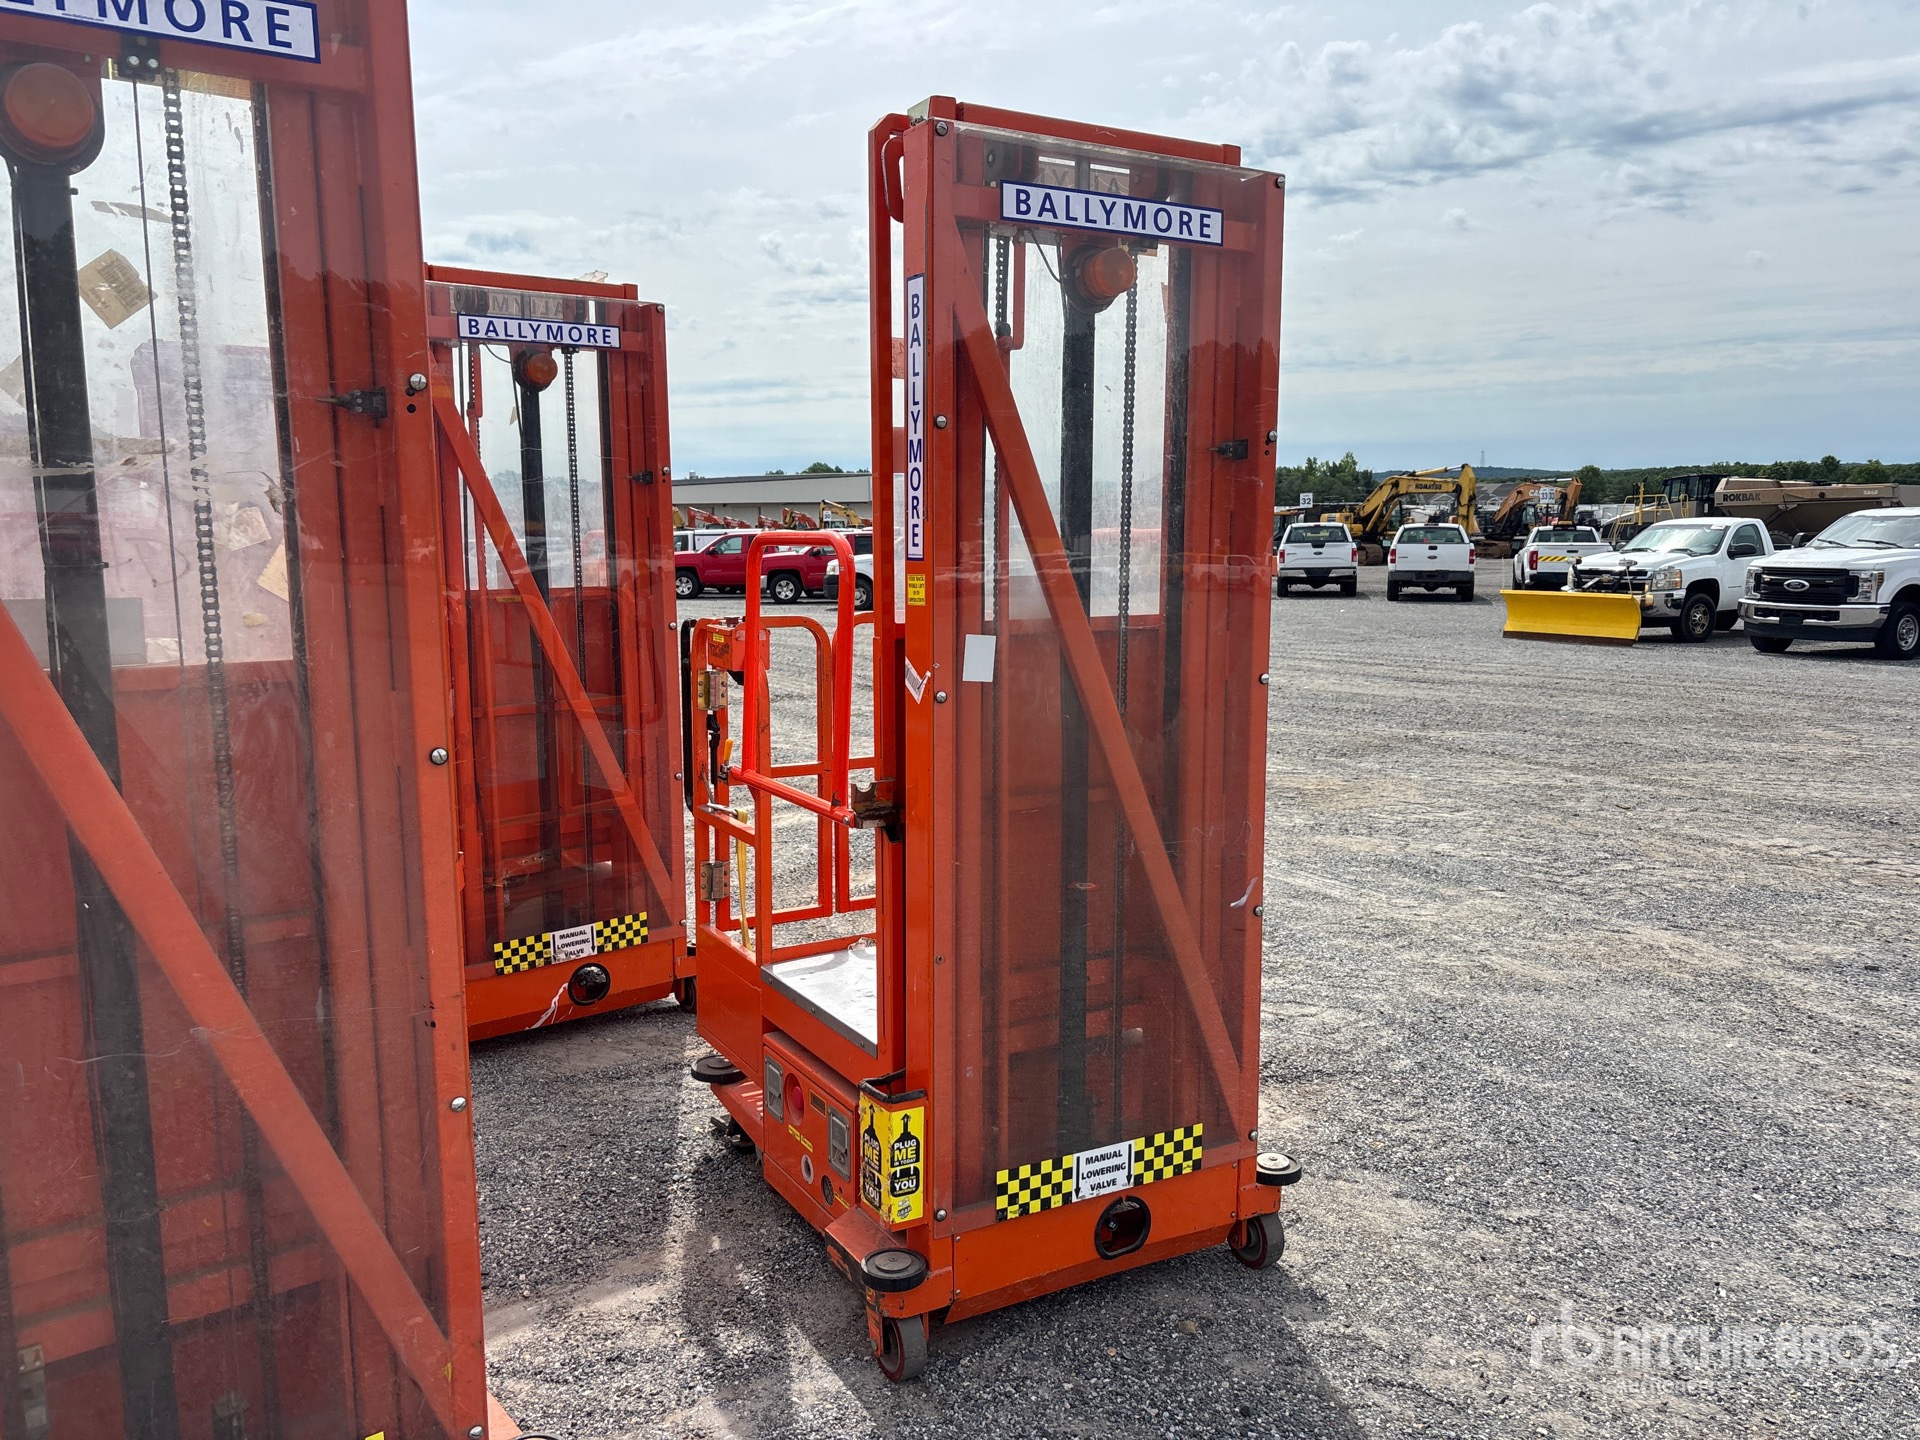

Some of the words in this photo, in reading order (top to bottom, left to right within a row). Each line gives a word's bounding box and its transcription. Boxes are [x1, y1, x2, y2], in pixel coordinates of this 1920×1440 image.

[7, 0, 294, 49] MORE
[1014, 188, 1212, 239] BALLYMORE
[467, 318, 613, 346] BALLYMORE
[908, 293, 923, 548] BALLYMORE
[1301, 497, 1311, 505] 32
[1722, 493, 1761, 502] ROKBAK
[559, 929, 588, 940] MANUAL
[557, 938, 590, 950] LOWERING
[564, 947, 585, 957] VALVE
[893, 1139, 917, 1150] PLUG
[864, 1141, 880, 1166] ME
[893, 1146, 917, 1161] ME
[1085, 1149, 1123, 1166] MANUAL
[1081, 1162, 1126, 1181] LOWERING
[894, 1179, 917, 1192] YOU
[1089, 1178, 1118, 1192] VALVE
